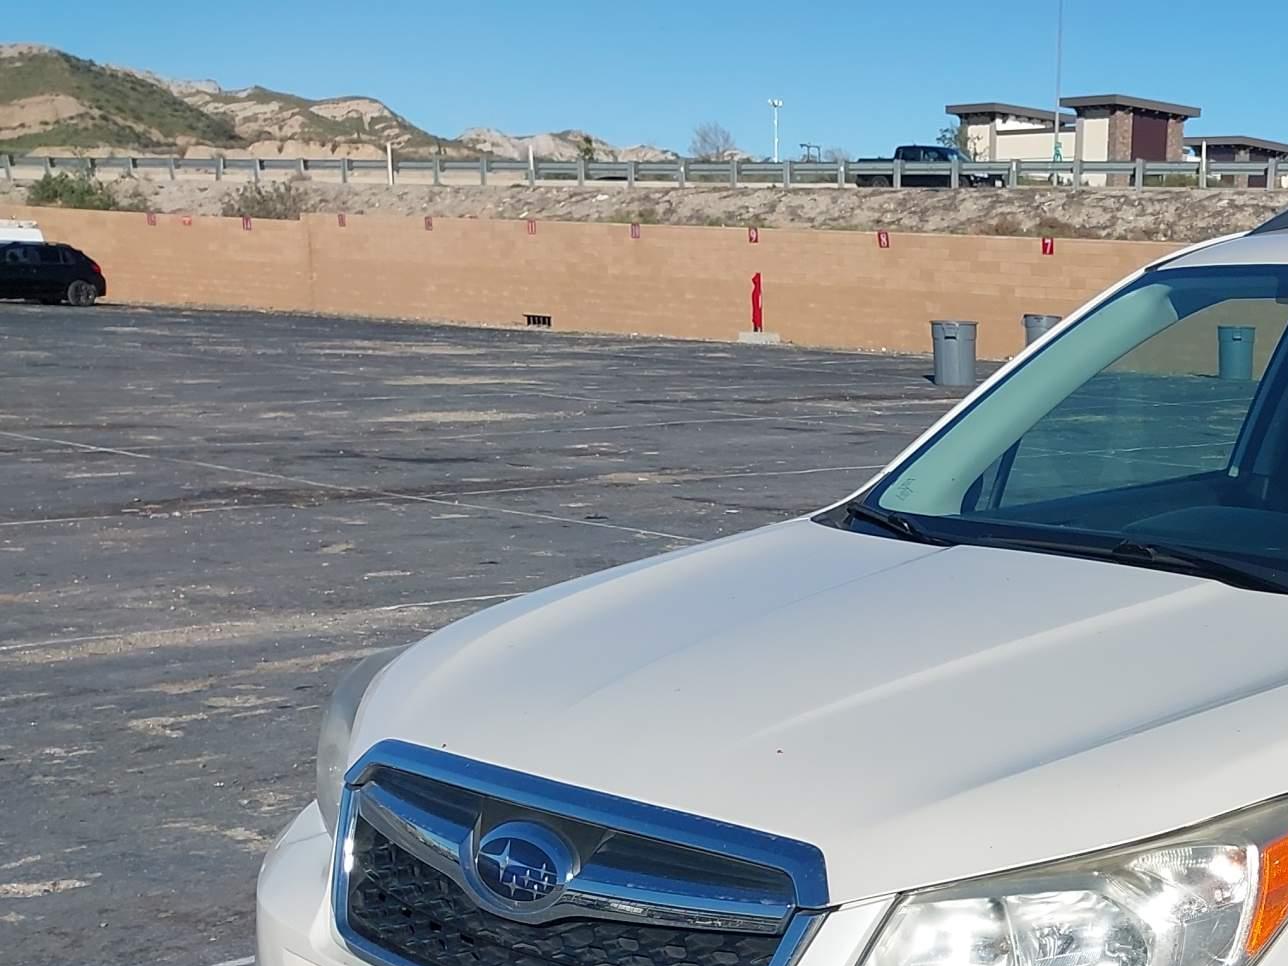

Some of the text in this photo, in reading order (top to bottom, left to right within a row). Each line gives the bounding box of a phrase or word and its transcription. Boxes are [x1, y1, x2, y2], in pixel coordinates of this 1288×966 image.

[750, 229, 757, 241] 9
[880, 233, 888, 247] 8
[1044, 239, 1052, 254] 7
